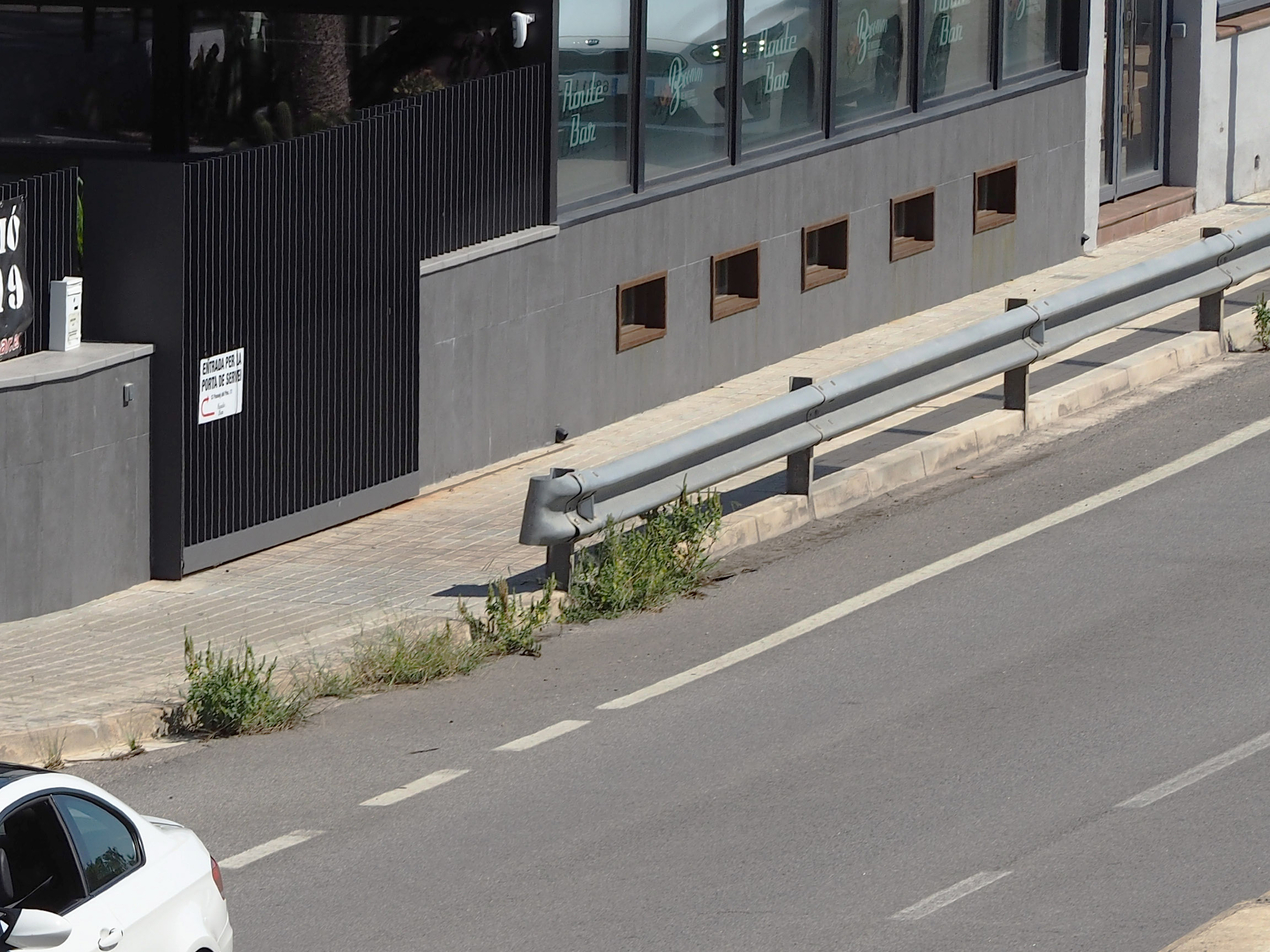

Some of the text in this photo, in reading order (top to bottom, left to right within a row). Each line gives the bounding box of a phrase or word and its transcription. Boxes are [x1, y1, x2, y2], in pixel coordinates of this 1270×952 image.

[939, 15, 963, 47] Bar
[562, 72, 605, 112] Route
[764, 61, 790, 94] Bar
[570, 113, 596, 148] Bar
